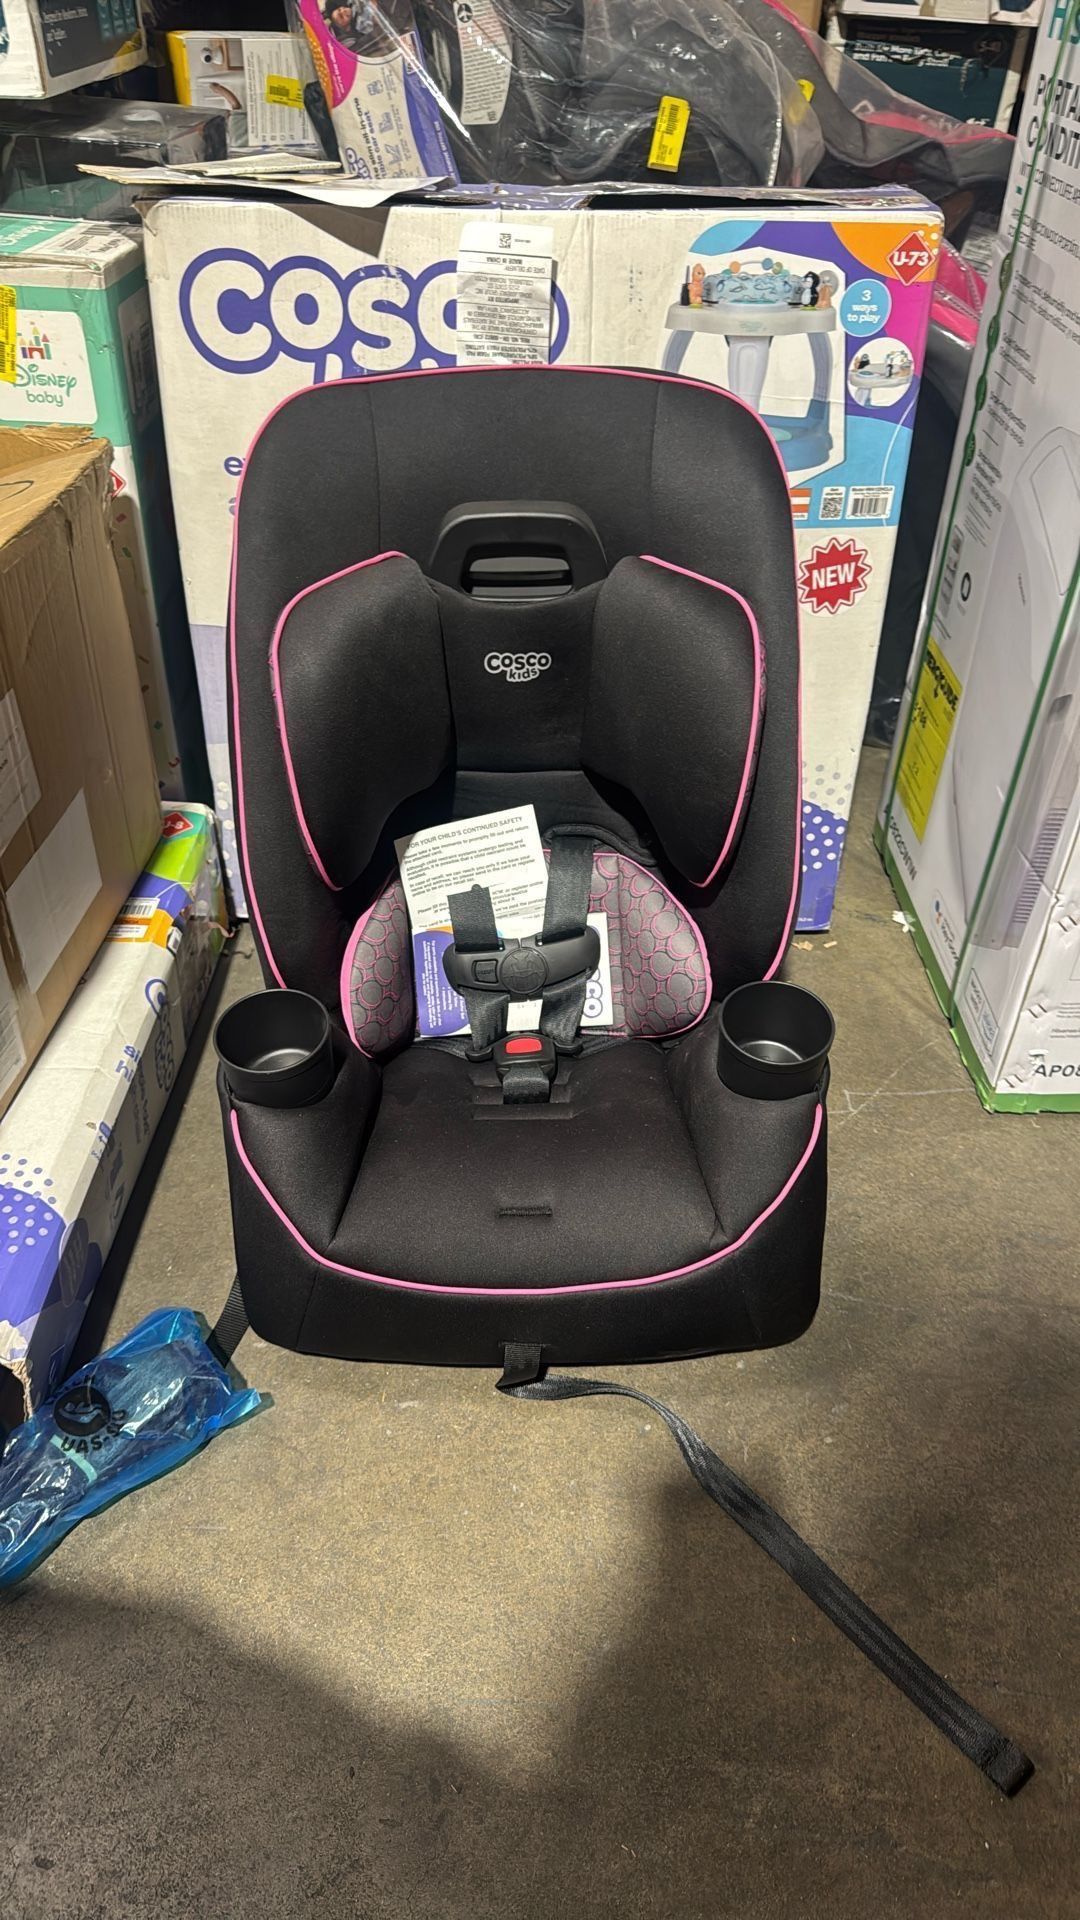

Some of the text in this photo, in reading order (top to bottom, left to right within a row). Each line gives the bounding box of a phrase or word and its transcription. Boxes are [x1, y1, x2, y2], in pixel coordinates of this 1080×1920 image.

[893, 251, 929, 267] U-73
[861, 289, 872, 302] 3
[851, 304, 878, 316] ways
[846, 314, 881, 324] to play
[25, 389, 64, 407] baby
[811, 561, 857, 590] NEW
[506, 668, 541, 682] kids
[420, 836, 437, 846] YOUR
[437, 830, 462, 841] CHILD'S
[462, 821, 499, 835] CONTINUED
[499, 816, 523, 826] SAFETY
